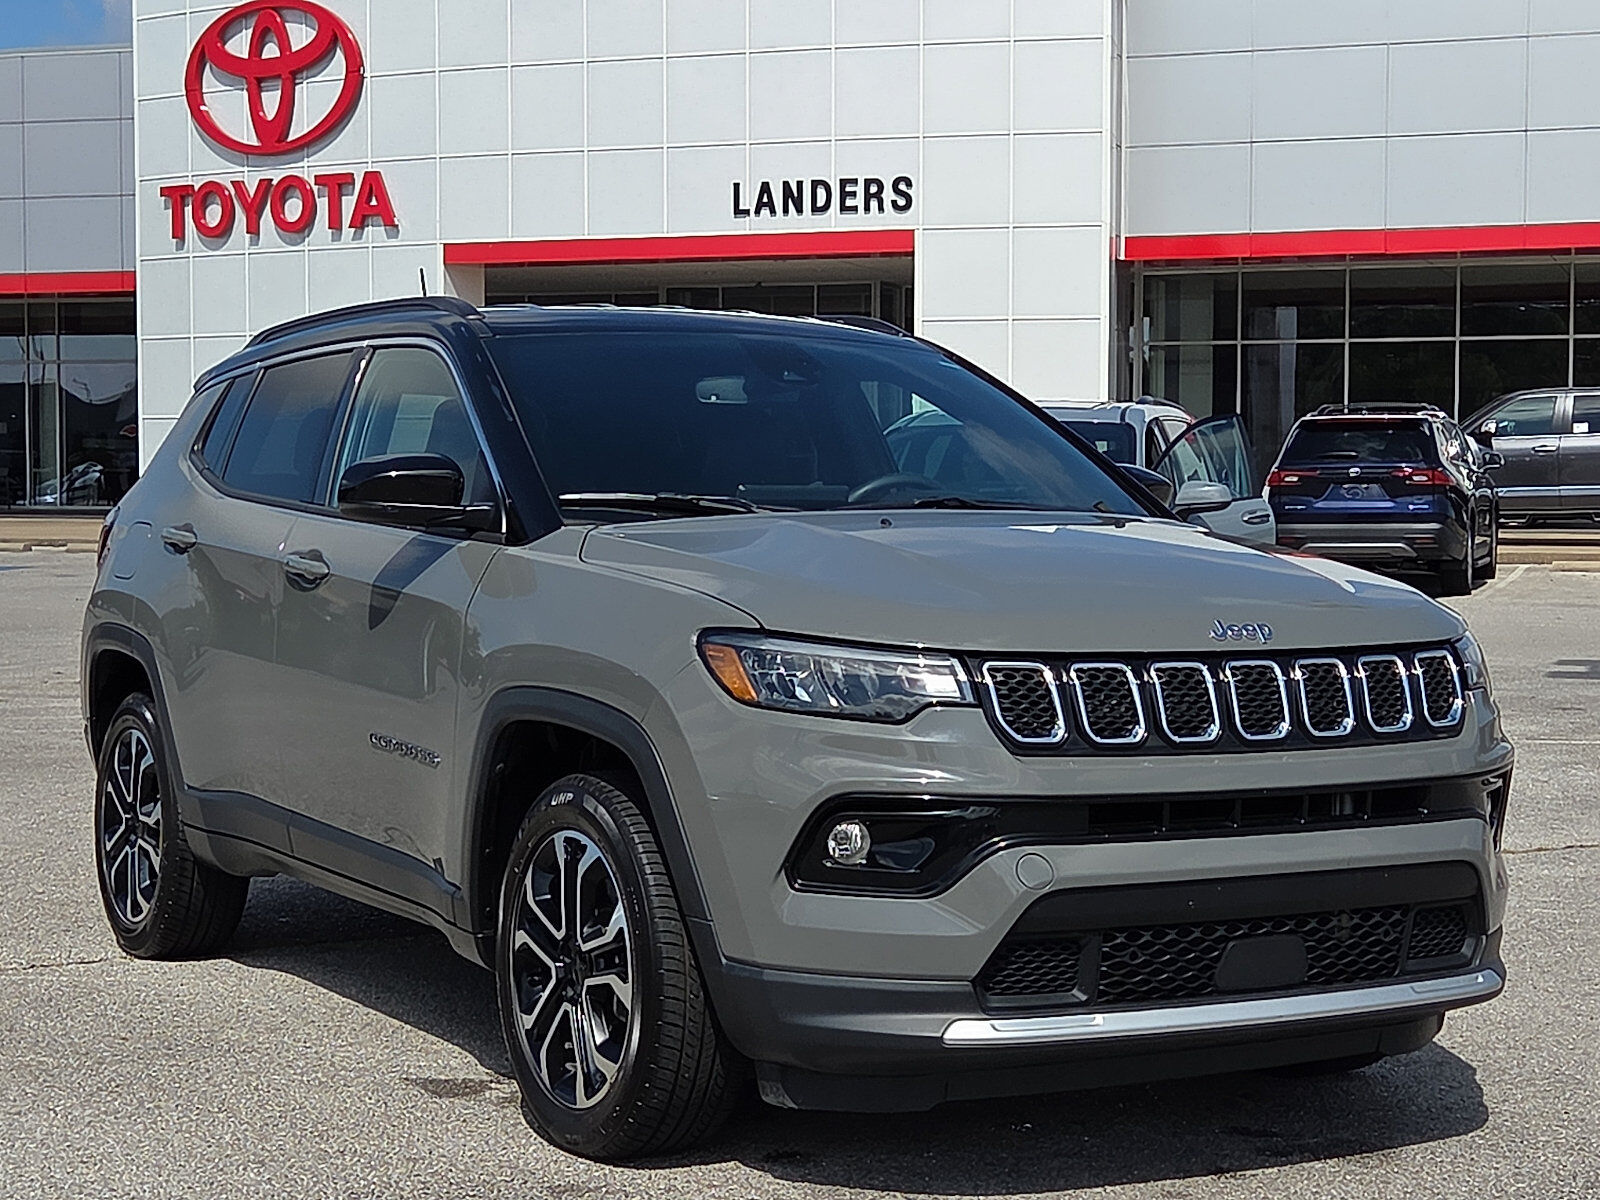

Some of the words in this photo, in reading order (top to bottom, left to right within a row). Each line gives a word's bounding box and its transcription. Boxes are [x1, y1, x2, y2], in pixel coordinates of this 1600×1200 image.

[160, 171, 397, 239] TOYOTA
[733, 176, 913, 217] LANDERS
[1209, 619, 1273, 644] Jeep
